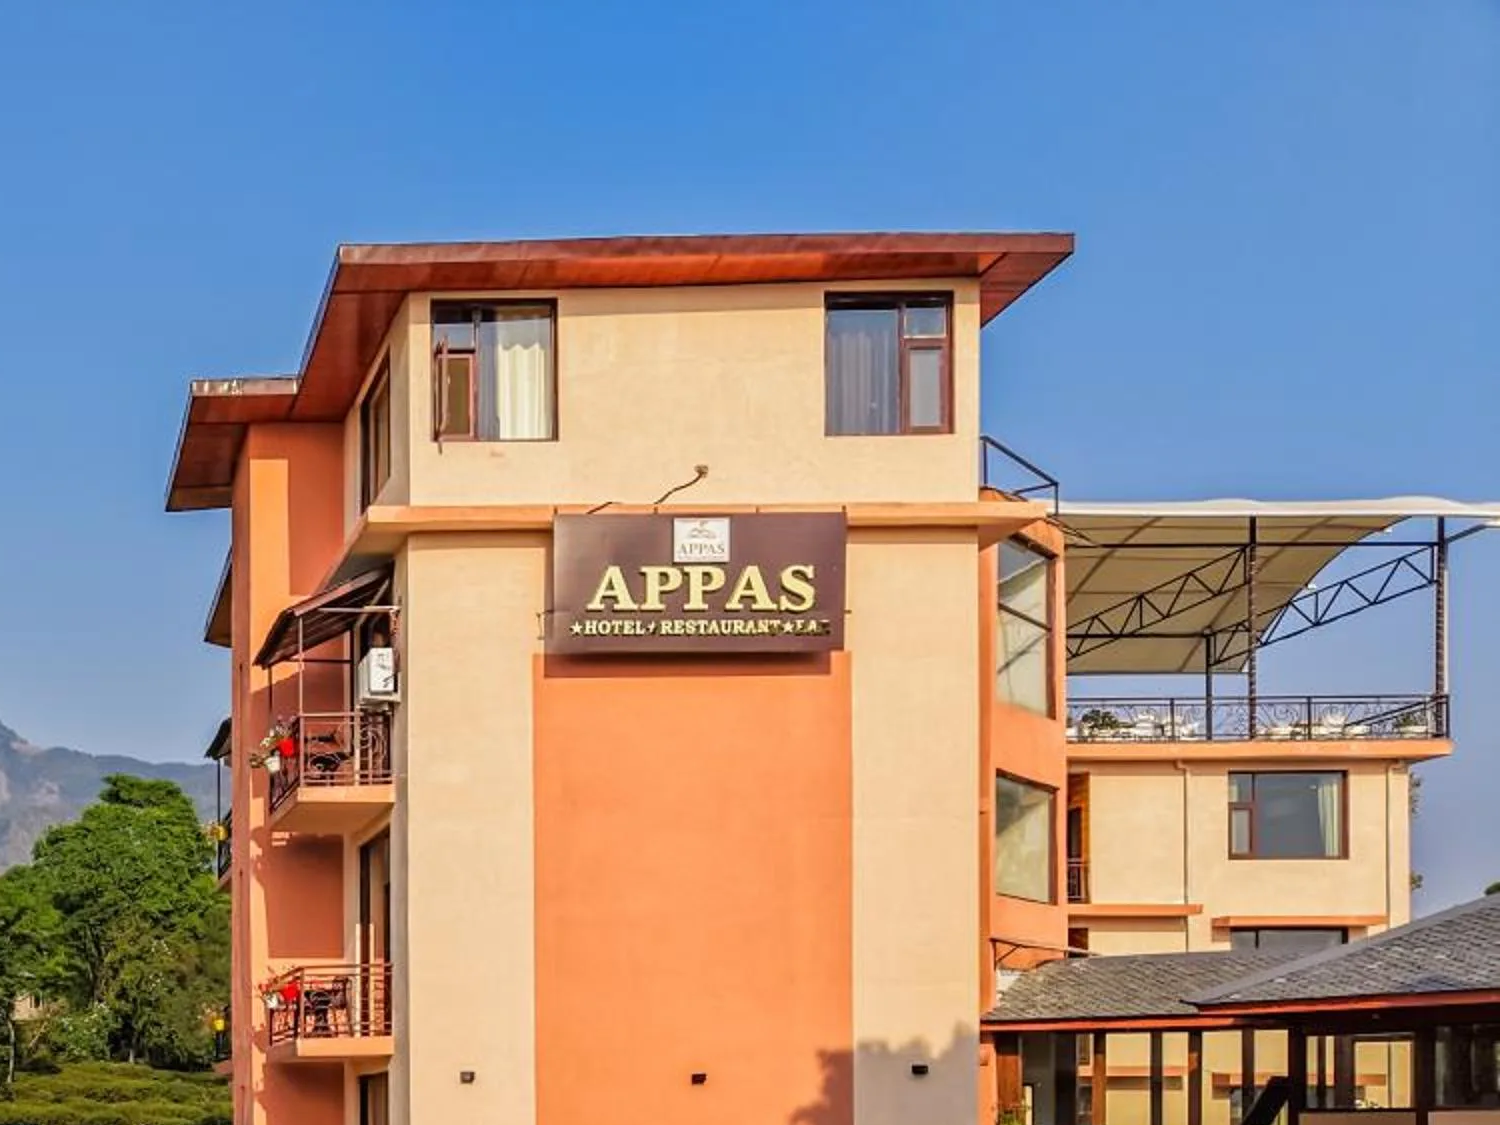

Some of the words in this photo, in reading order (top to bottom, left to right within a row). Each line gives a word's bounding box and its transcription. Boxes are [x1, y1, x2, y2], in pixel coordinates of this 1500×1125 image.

[586, 565, 817, 613] APPAS
[583, 619, 646, 635] HOTEL
[659, 619, 781, 635] RESTAURANT
